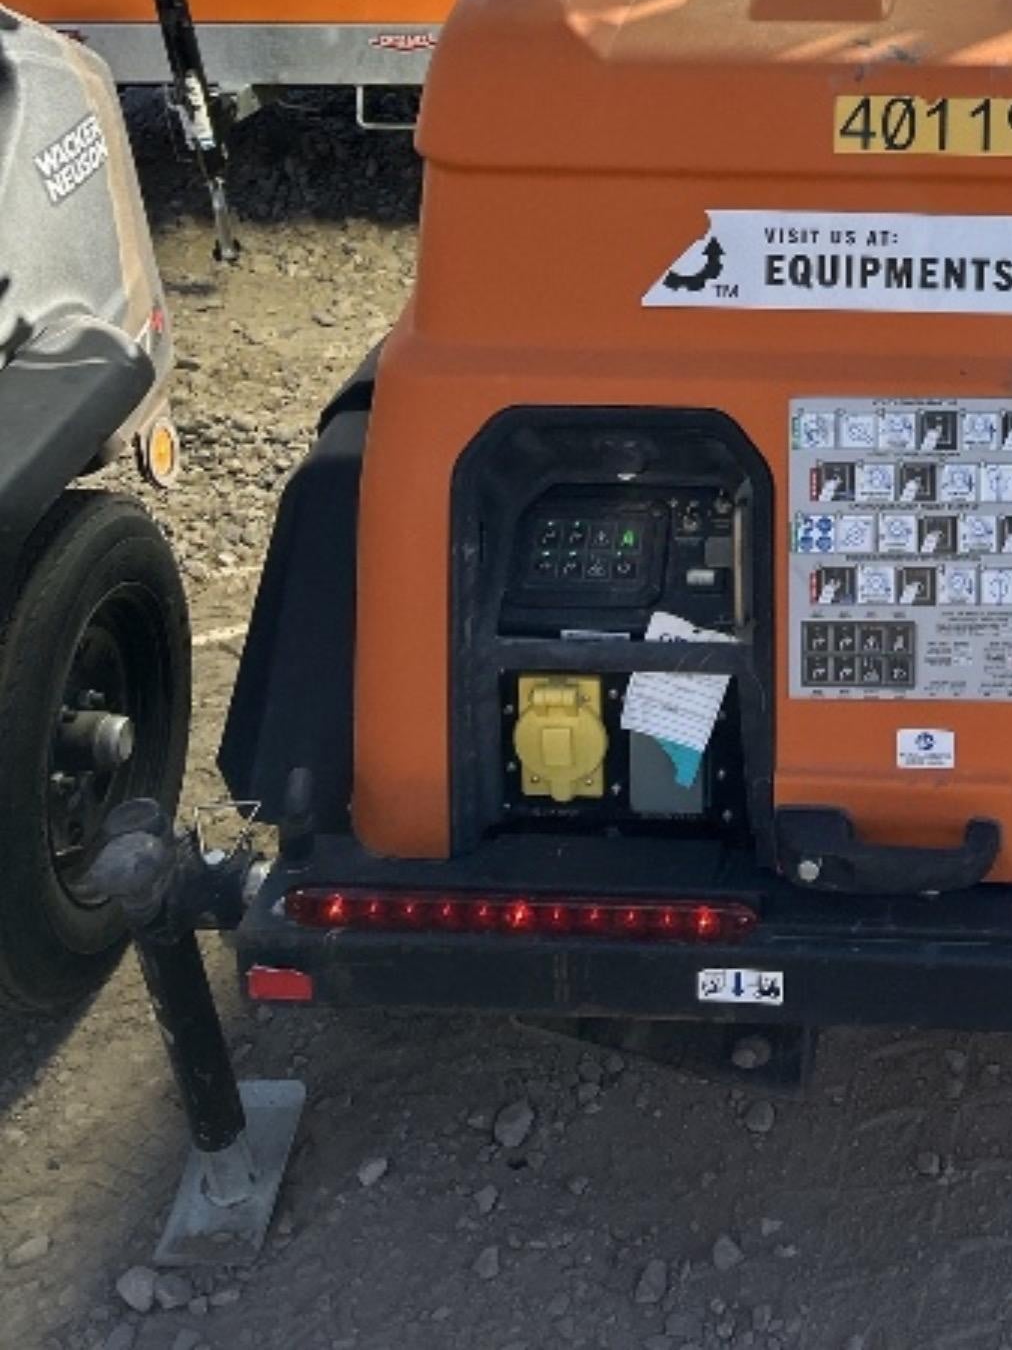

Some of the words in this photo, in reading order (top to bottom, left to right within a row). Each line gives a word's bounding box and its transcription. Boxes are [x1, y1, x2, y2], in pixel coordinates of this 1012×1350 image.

[764, 227, 820, 245] VISIT
[830, 229, 856, 246] US
[866, 230, 899, 247] AT:
